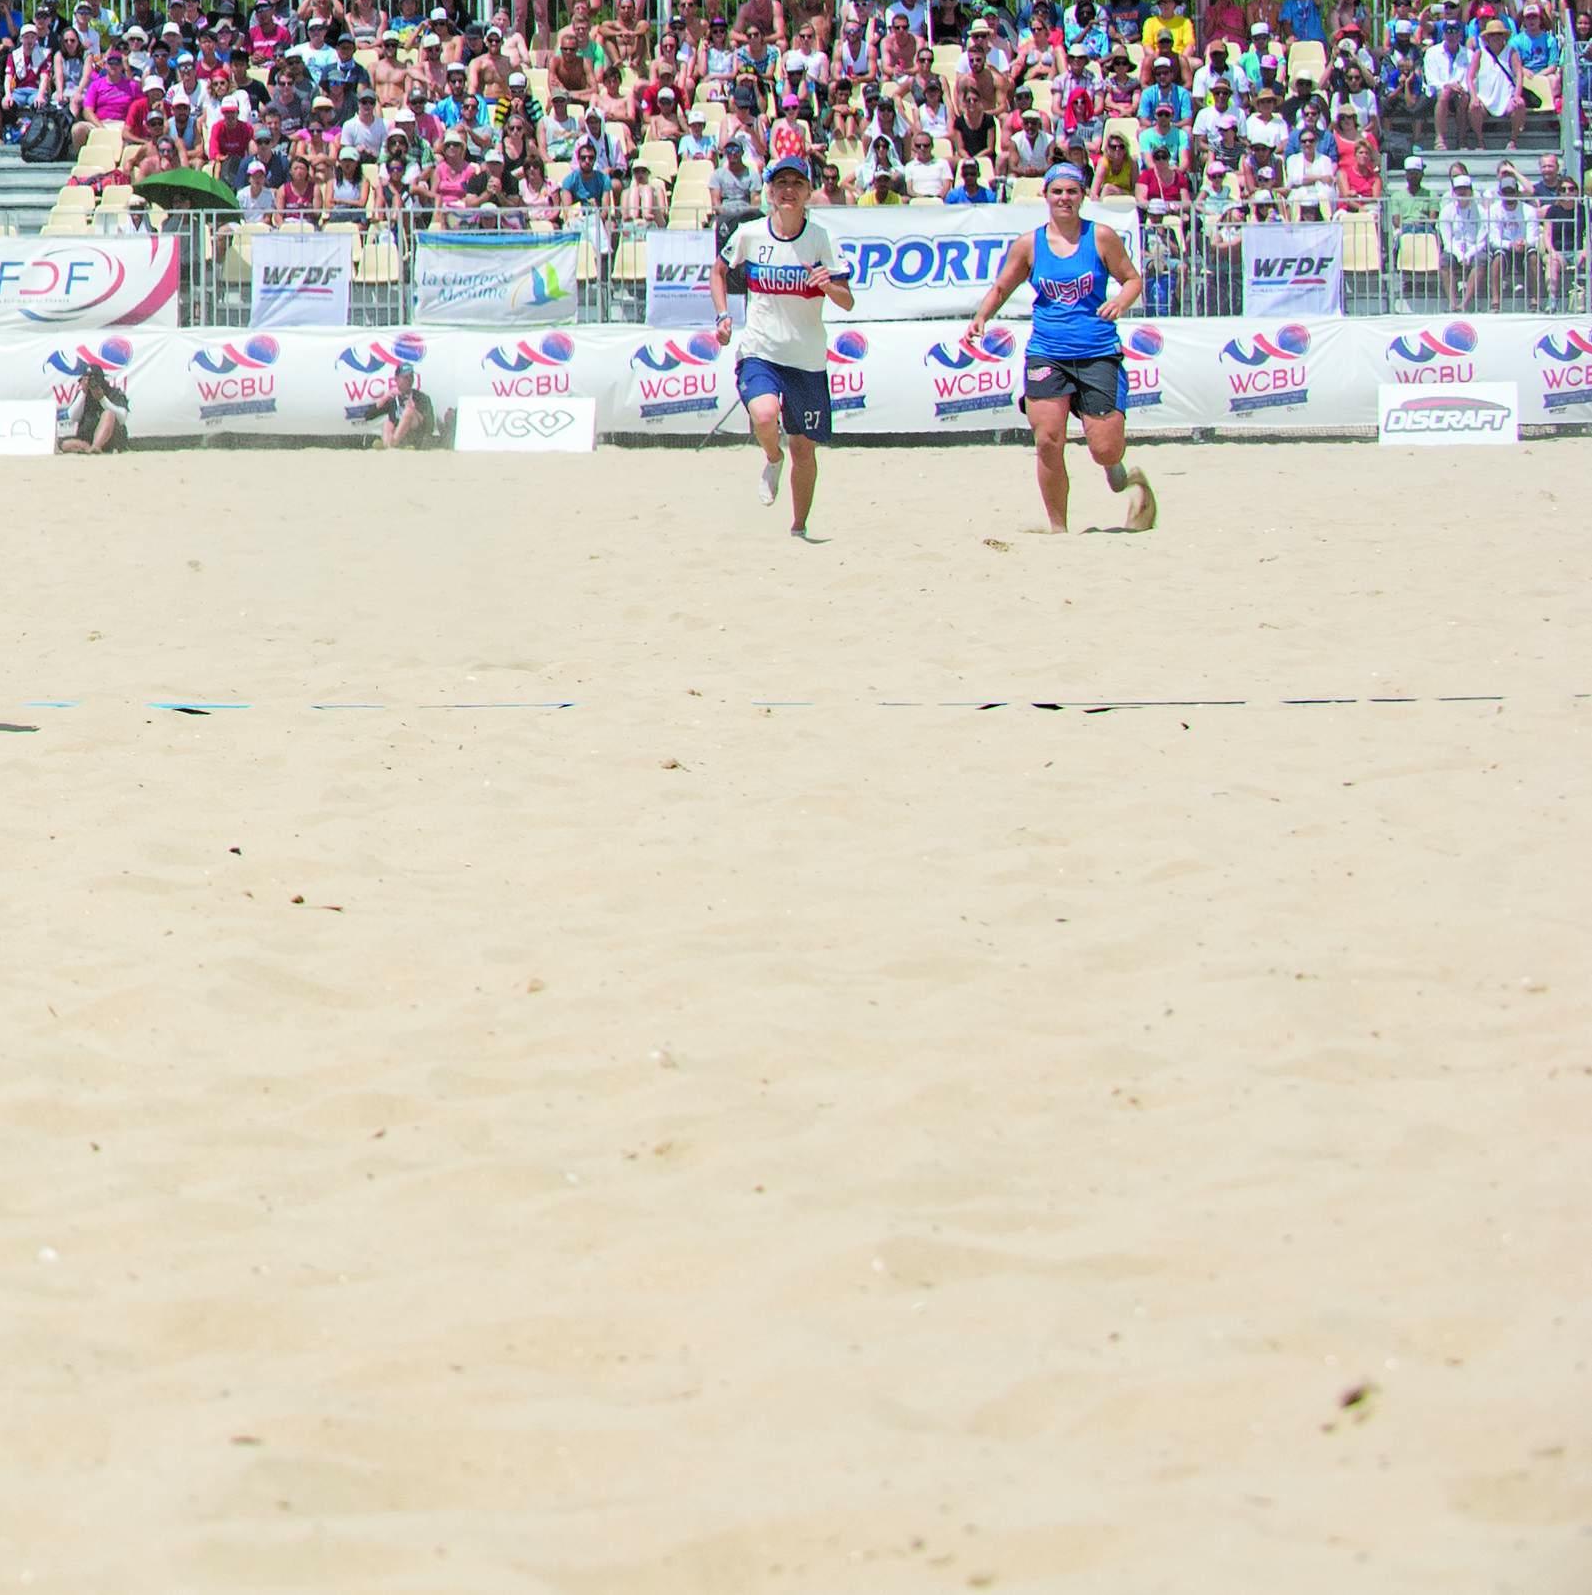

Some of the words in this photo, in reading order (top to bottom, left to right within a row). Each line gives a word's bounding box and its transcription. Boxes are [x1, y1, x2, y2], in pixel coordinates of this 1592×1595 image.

[759, 246, 774, 264] 27
[839, 236, 1013, 286] SPORT
[1253, 256, 1334, 278] WFDF
[262, 265, 343, 286] WFDF
[758, 268, 809, 292] RUSSIA
[1038, 270, 1094, 304] USA
[830, 371, 864, 395] BU
[934, 369, 1012, 399] WCBU
[1128, 367, 1159, 391] BU
[1229, 365, 1306, 395] WCBU
[1395, 362, 1474, 384] WCBU
[197, 374, 275, 403] WCBU
[492, 373, 570, 398] WCBU
[640, 373, 717, 400] WCBU
[803, 411, 821, 431] 27
[1385, 407, 1512, 434] DISCRAFT
